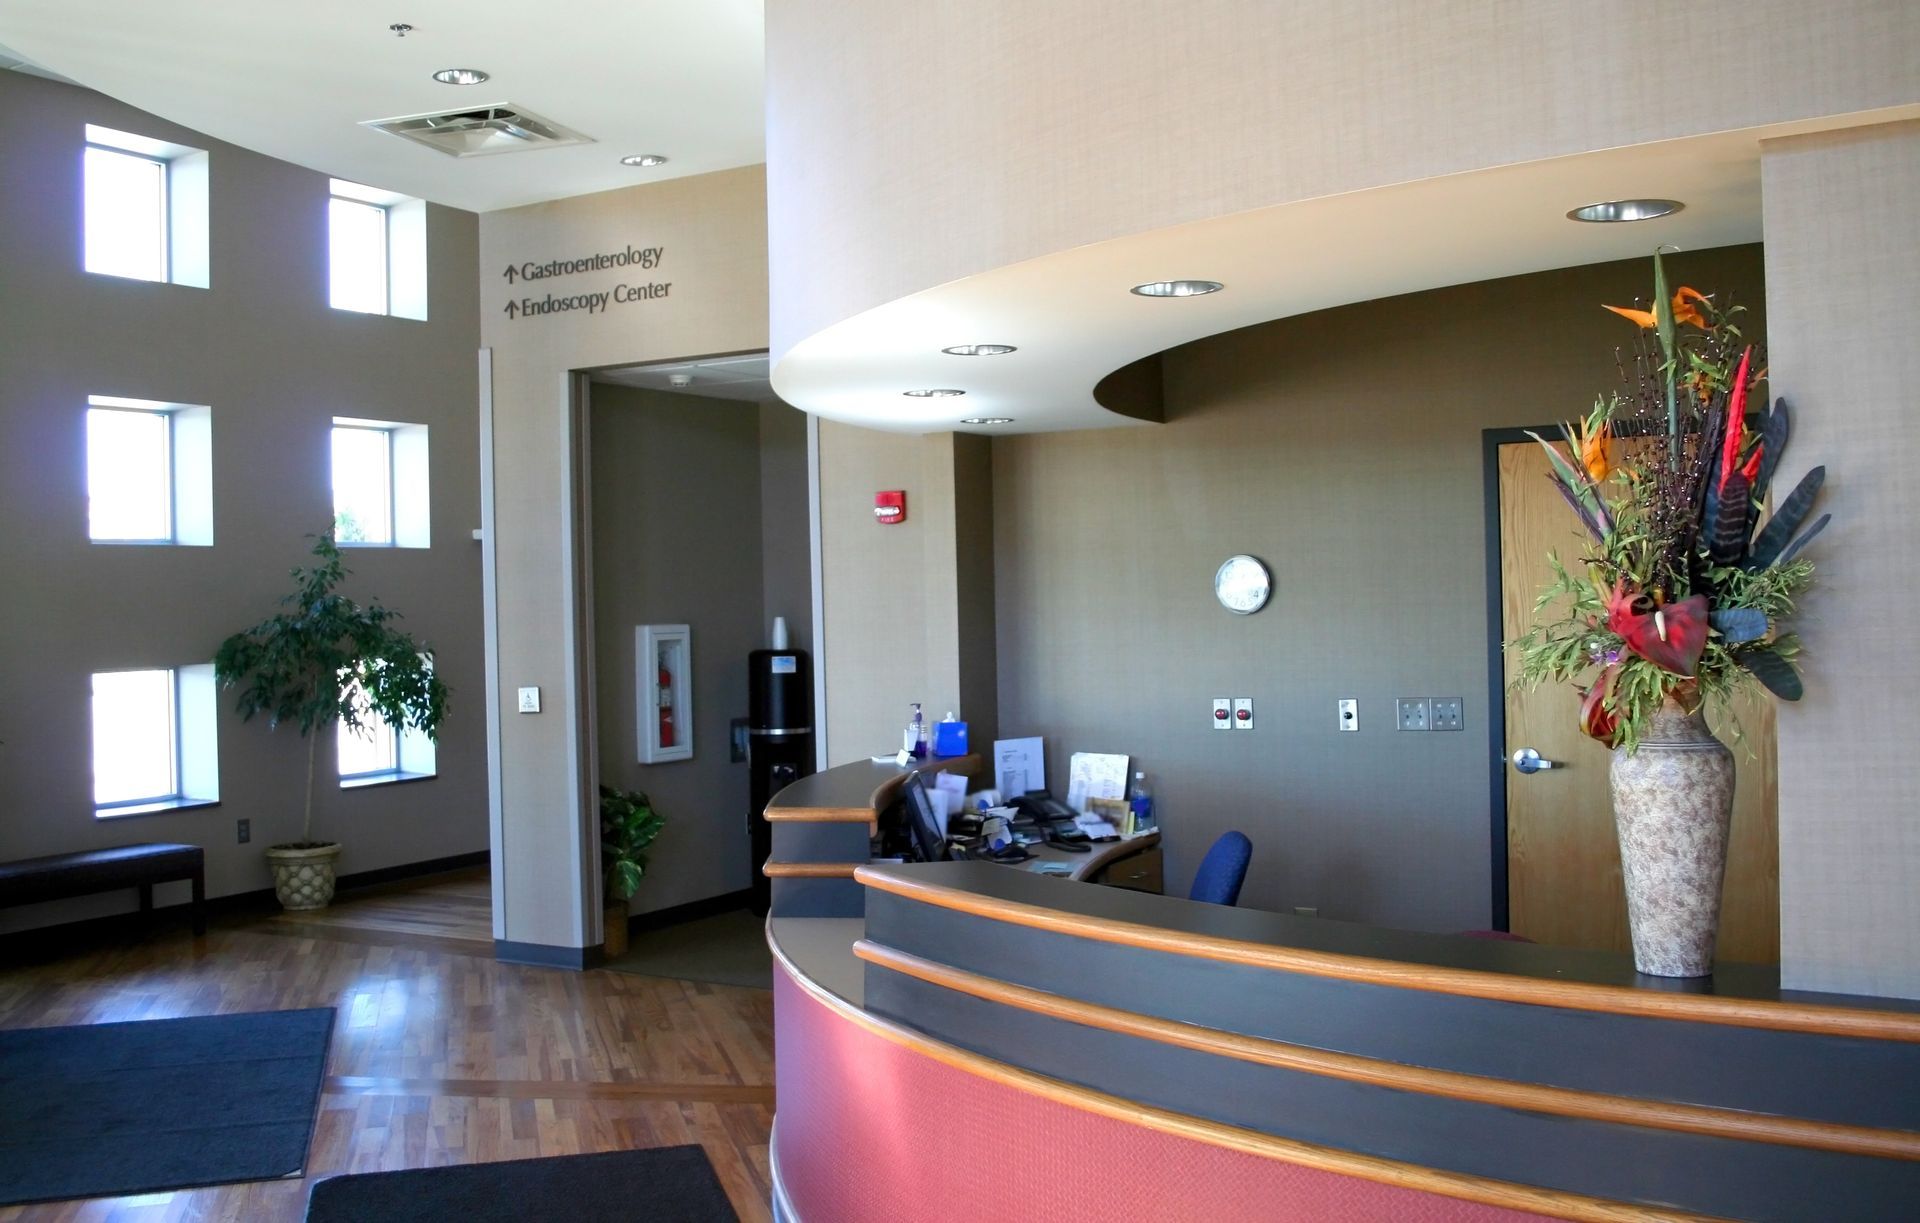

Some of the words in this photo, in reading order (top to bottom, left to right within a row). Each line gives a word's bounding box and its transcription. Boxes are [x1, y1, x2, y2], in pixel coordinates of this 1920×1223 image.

[521, 245, 664, 281] Gastroenterology
[521, 292, 610, 317] Endoscopy
[613, 281, 673, 303] Center
